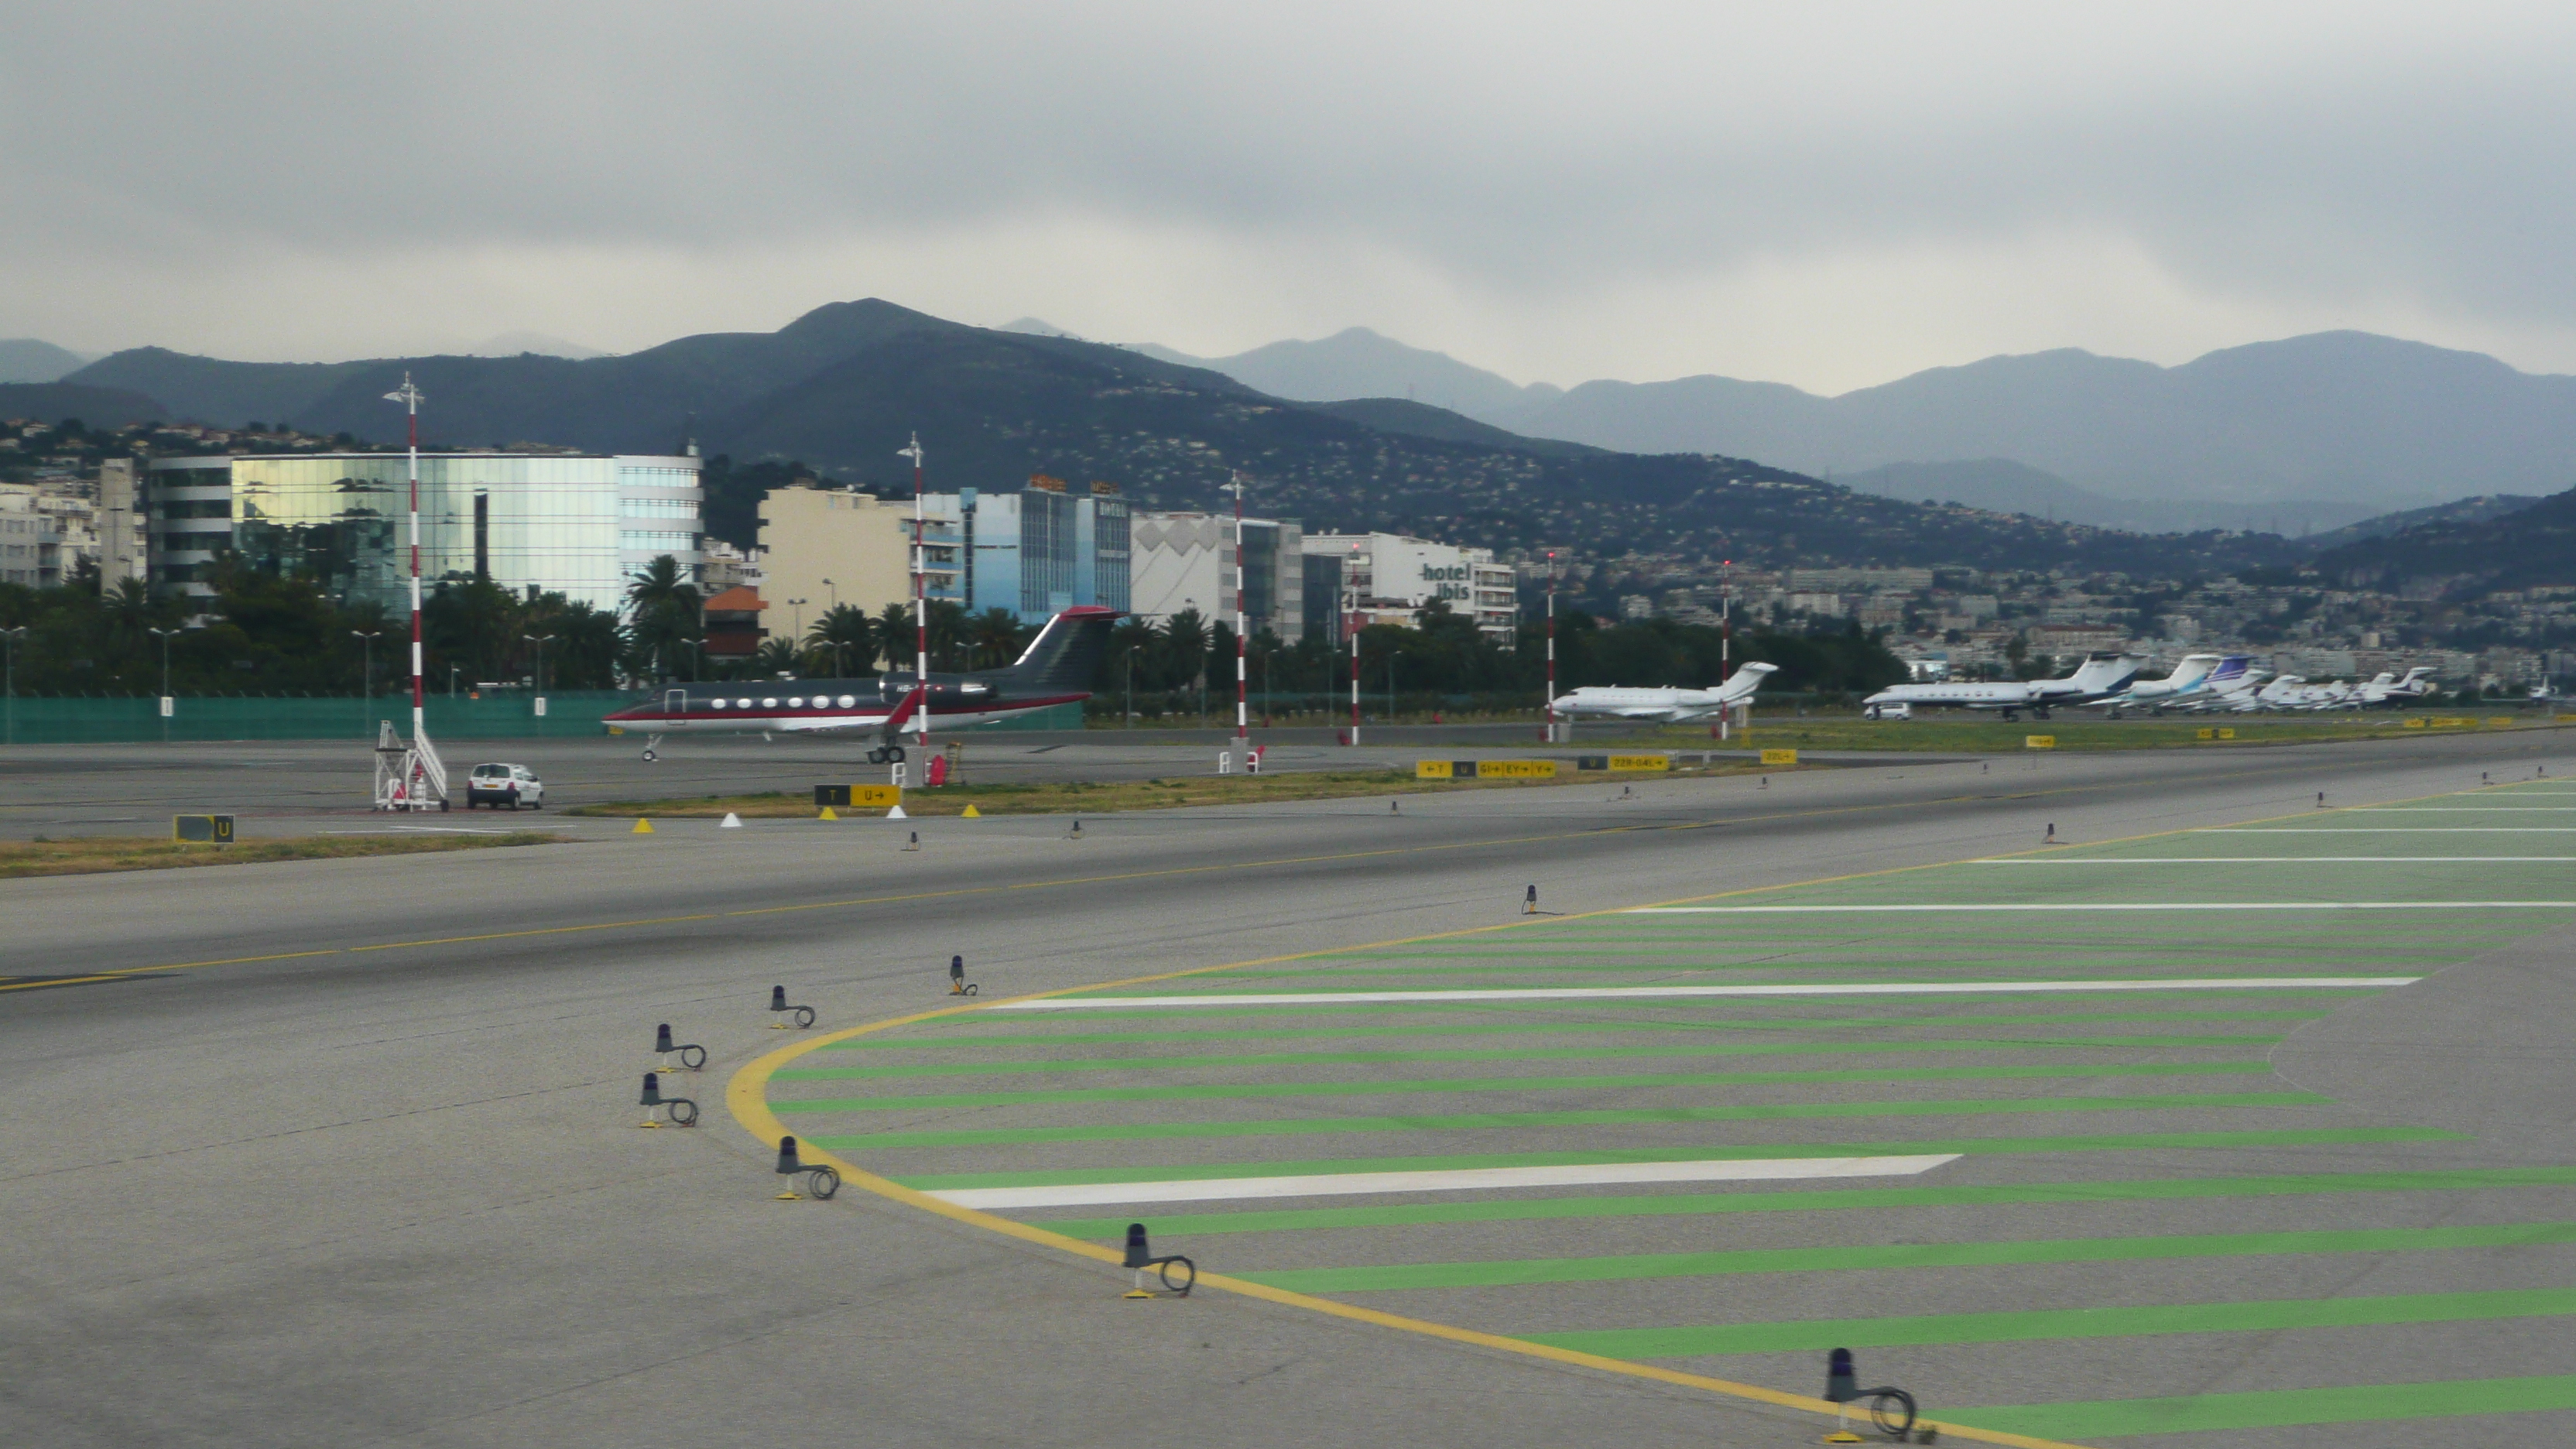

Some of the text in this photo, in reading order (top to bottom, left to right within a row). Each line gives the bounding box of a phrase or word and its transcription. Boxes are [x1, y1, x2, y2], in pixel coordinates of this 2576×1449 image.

[1423, 563, 1471, 581] hotel
[1436, 582, 1469, 600] ibis
[828, 789, 872, 801] T U
[218, 821, 230, 837] U
